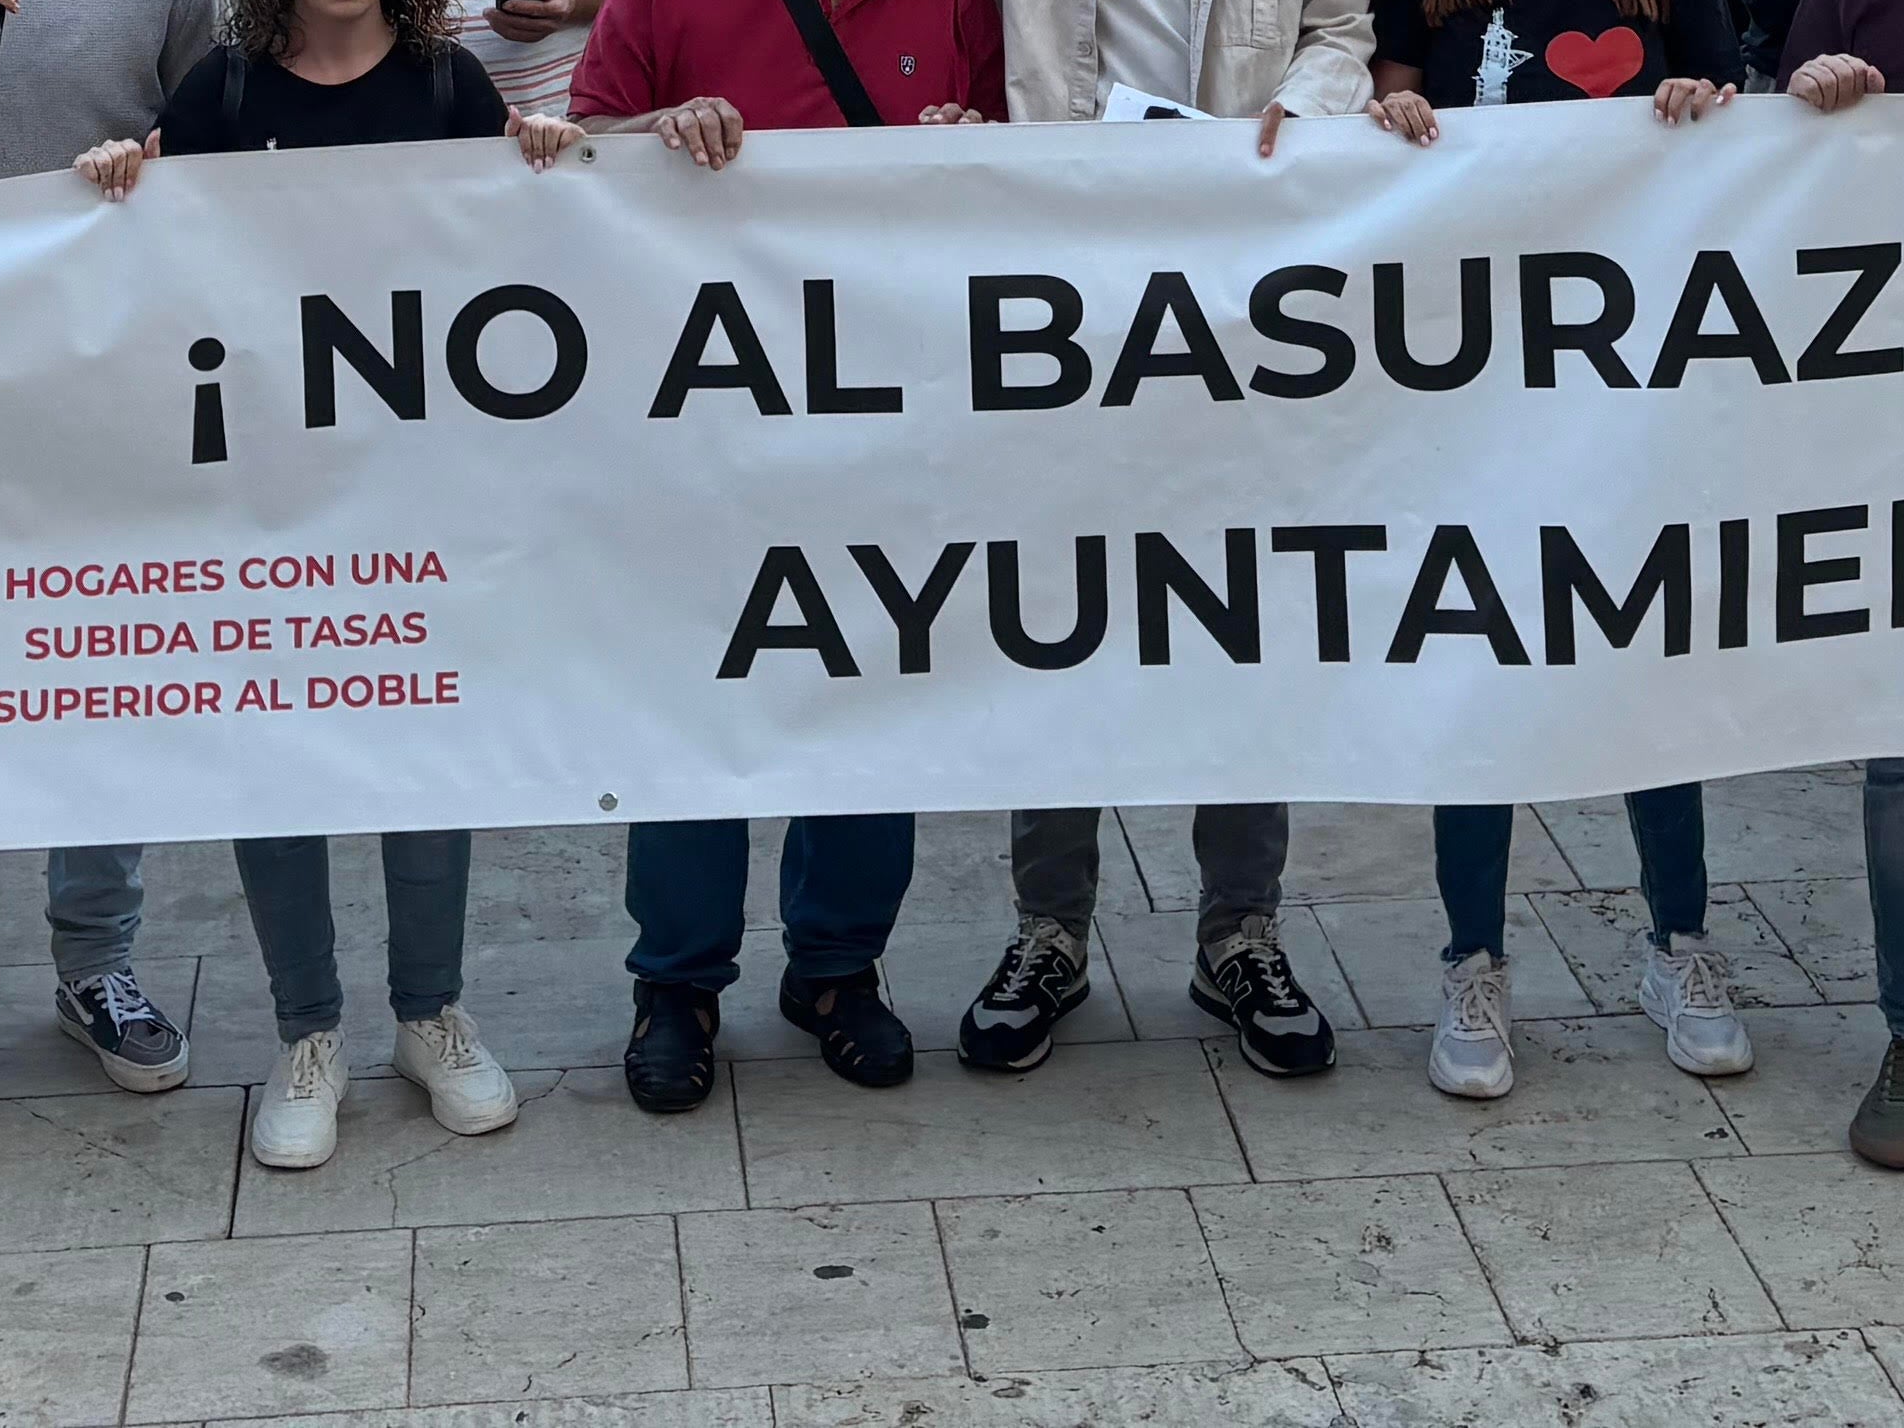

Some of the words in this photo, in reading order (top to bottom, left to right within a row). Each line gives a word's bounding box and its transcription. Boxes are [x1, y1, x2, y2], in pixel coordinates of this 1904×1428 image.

[646, 278, 905, 419] AL
[5, 559, 226, 600] HOGARES
[238, 556, 334, 590] CON
[351, 551, 447, 586] UNA
[25, 623, 198, 660] SUBIDA
[212, 619, 271, 652] DE
[286, 612, 428, 649] TASAS
[237, 679, 292, 712] AL
[308, 672, 460, 710] DOBLE
